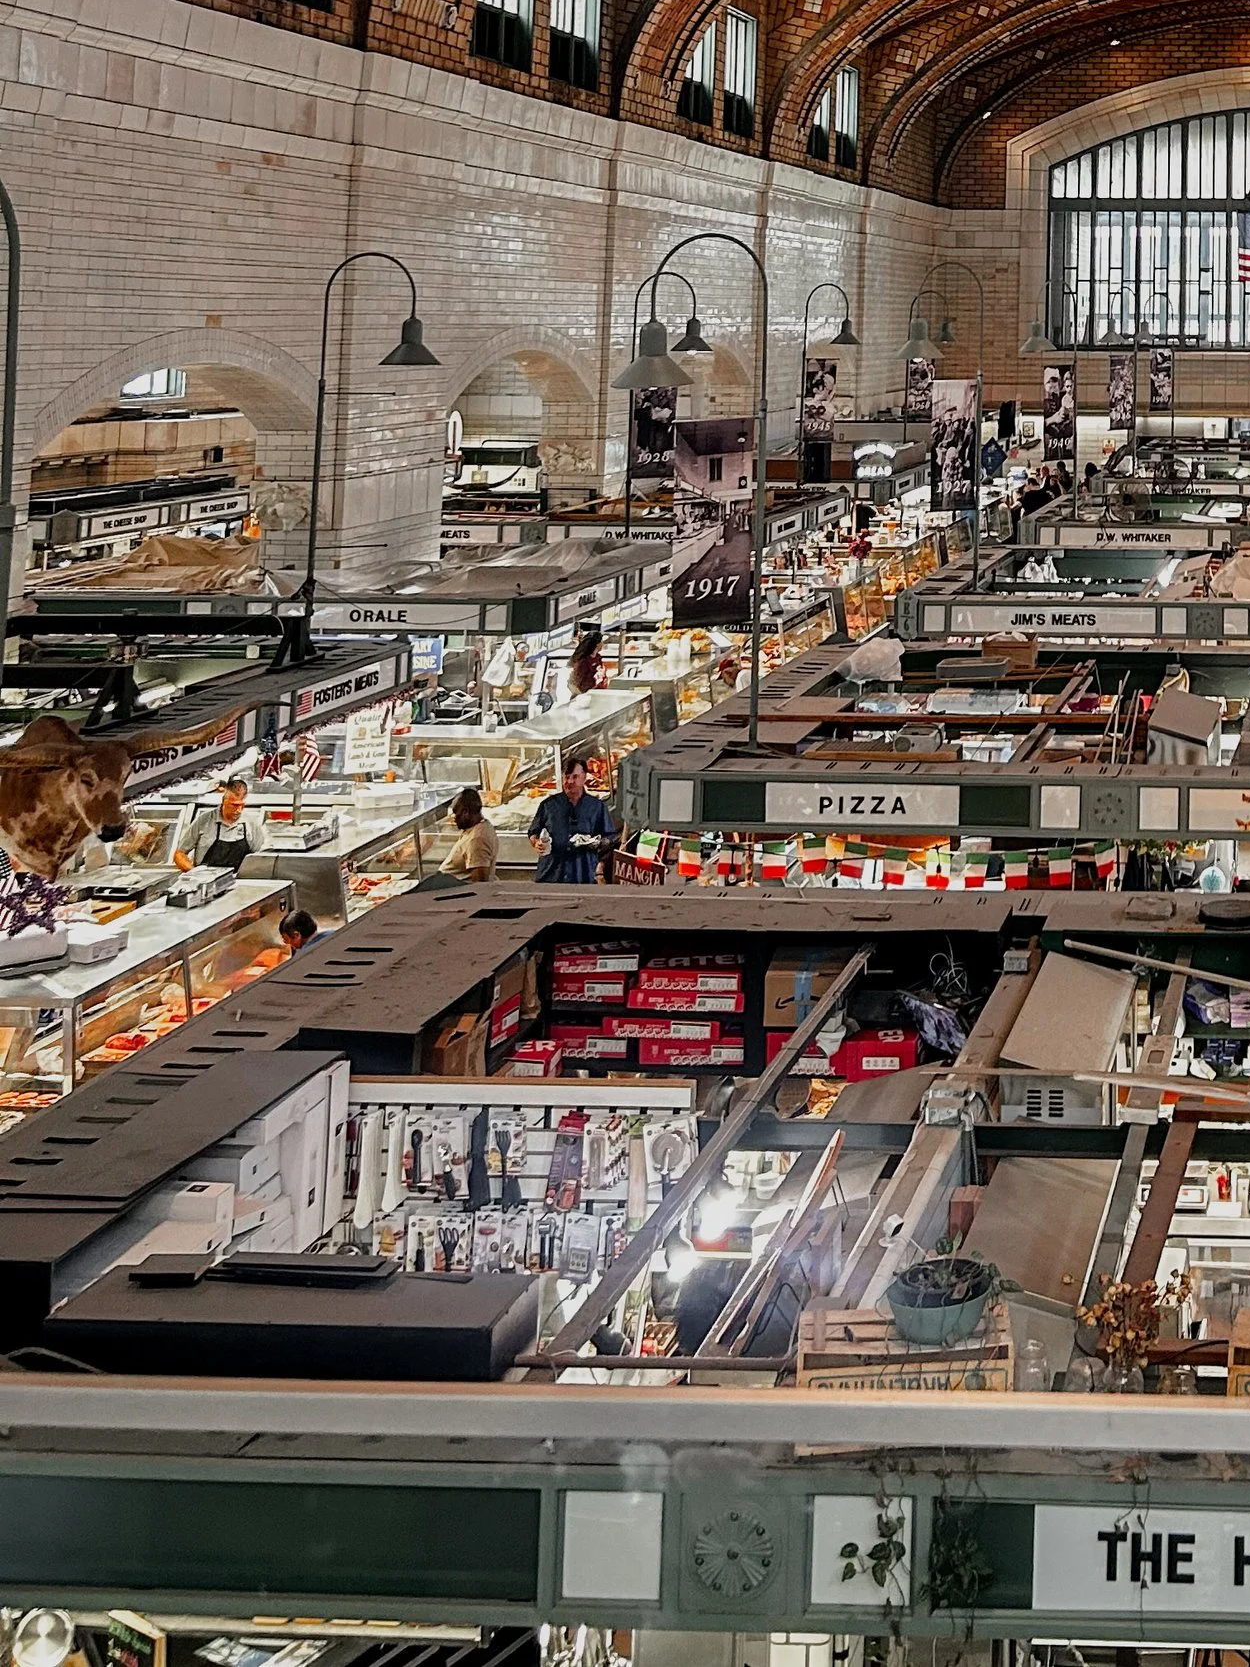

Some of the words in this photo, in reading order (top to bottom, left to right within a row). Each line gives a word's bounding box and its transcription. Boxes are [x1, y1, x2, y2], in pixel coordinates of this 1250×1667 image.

[806, 420, 832, 432] 1945
[636, 451, 671, 465] 1928
[936, 479, 971, 495] 1927
[226, 501, 239, 511] SHOP
[133, 515, 147, 525] SHOP
[631, 531, 674, 541] WHITAKE
[1096, 533, 1118, 543] D.W.
[1122, 533, 1172, 543] WHITAKER
[684, 574, 741, 602] 1917
[349, 609, 408, 623] ORALE
[1010, 614, 1046, 626] JIM'S
[1051, 613, 1097, 626] MEATS
[722, 624, 750, 632] COLD
[313, 679, 352, 708] FOSTER'S
[353, 670, 380, 693] MEATS
[818, 796, 907, 815] PIZZA
[614, 860, 661, 886] MANGIA
[1097, 1531, 1197, 1585] THE
